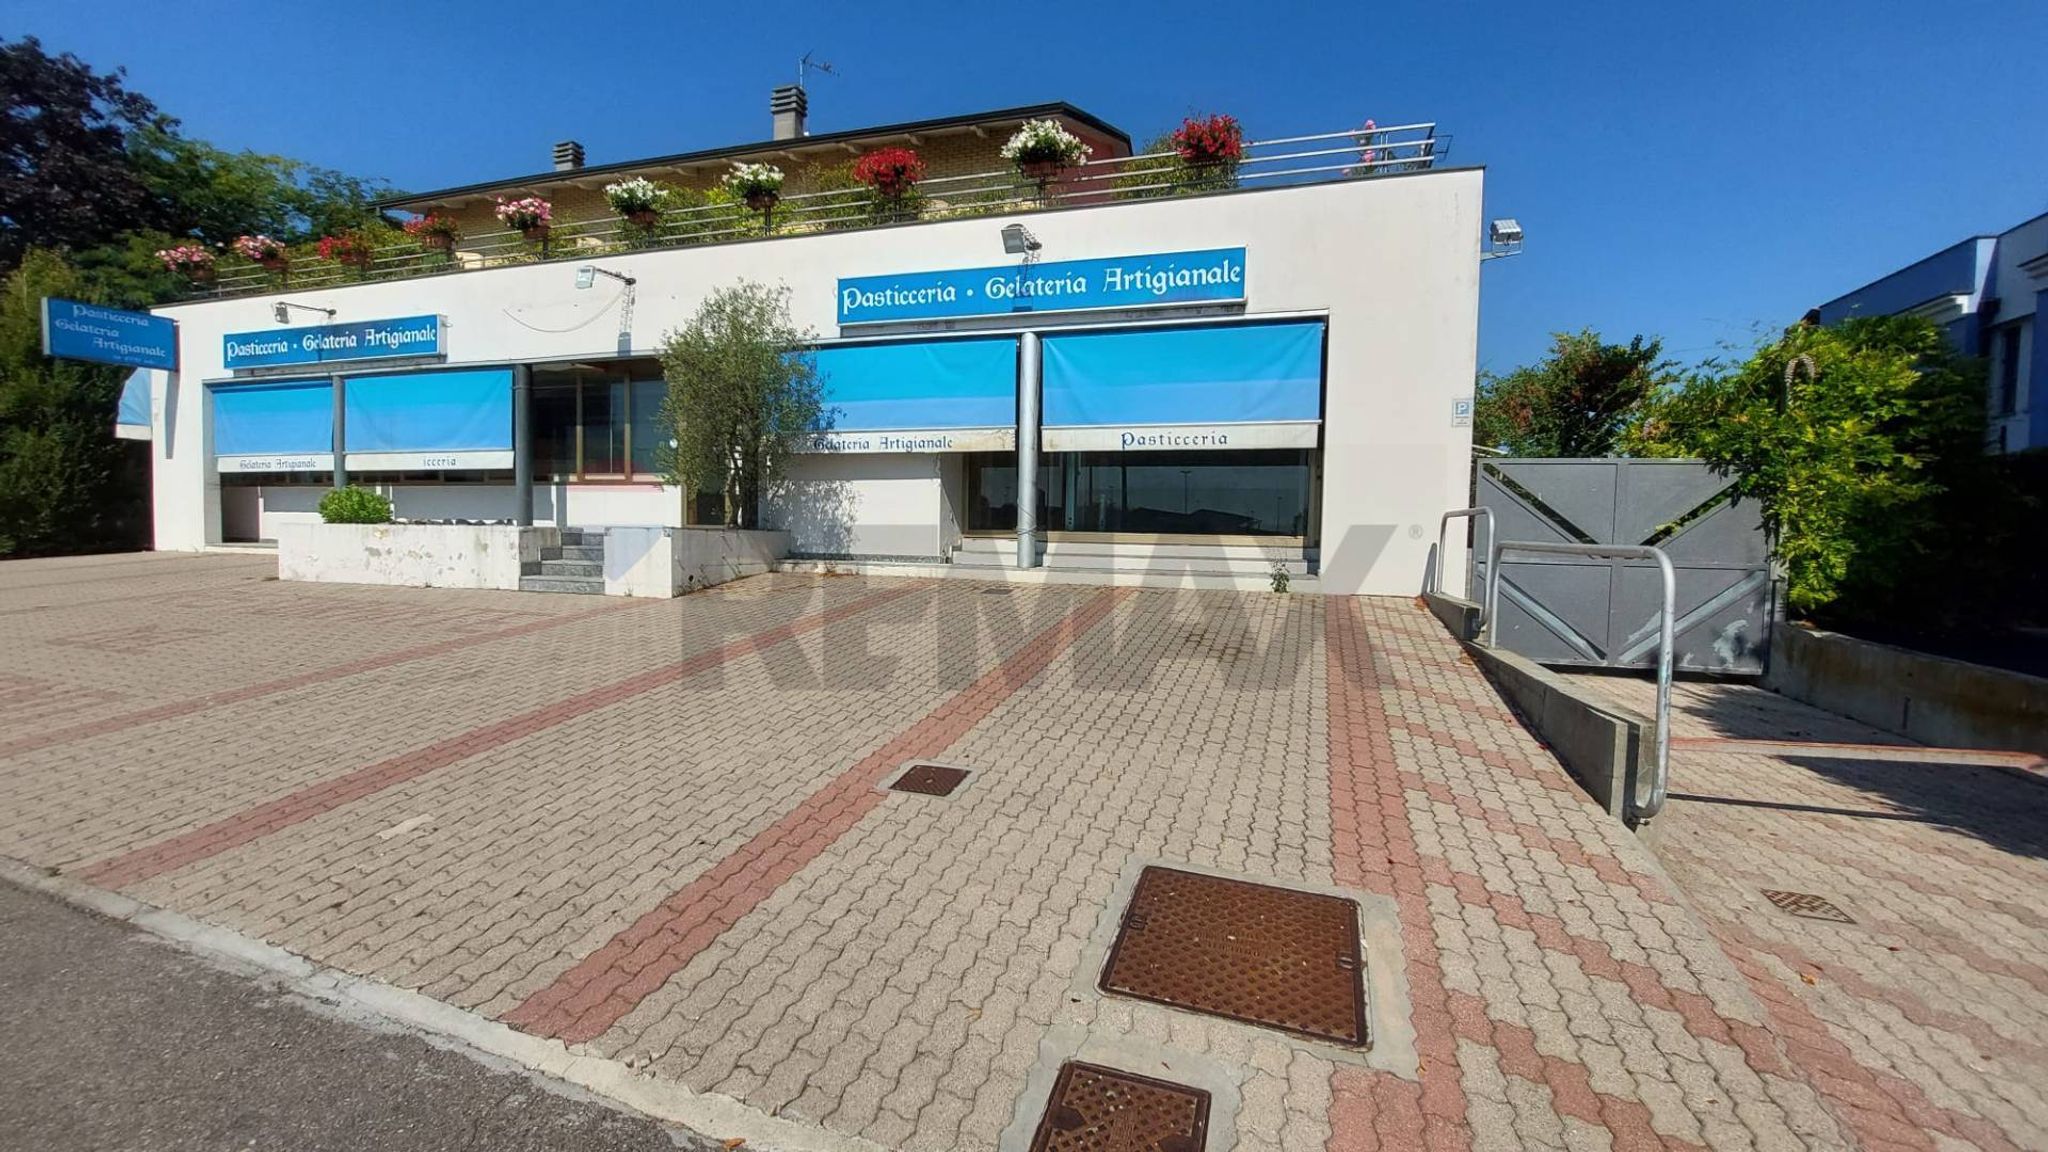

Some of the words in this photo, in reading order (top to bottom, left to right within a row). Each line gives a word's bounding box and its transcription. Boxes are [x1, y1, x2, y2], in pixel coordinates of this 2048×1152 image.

[842, 280, 956, 315] Pasticceria
[984, 270, 1087, 300] Gelateria
[1102, 260, 1241, 296] Artigianale
[73, 303, 150, 327] Pasticceria
[55, 318, 121, 338] Gelateria
[93, 337, 166, 358] Artigianale
[226, 336, 288, 361] Pasticceria
[302, 330, 357, 351] Gelateria
[364, 324, 436, 349] Artigianale
[812, 435, 870, 451] Gelateria
[879, 435, 953, 452] Artigianale
[1121, 430, 1229, 450] Pasticceria
